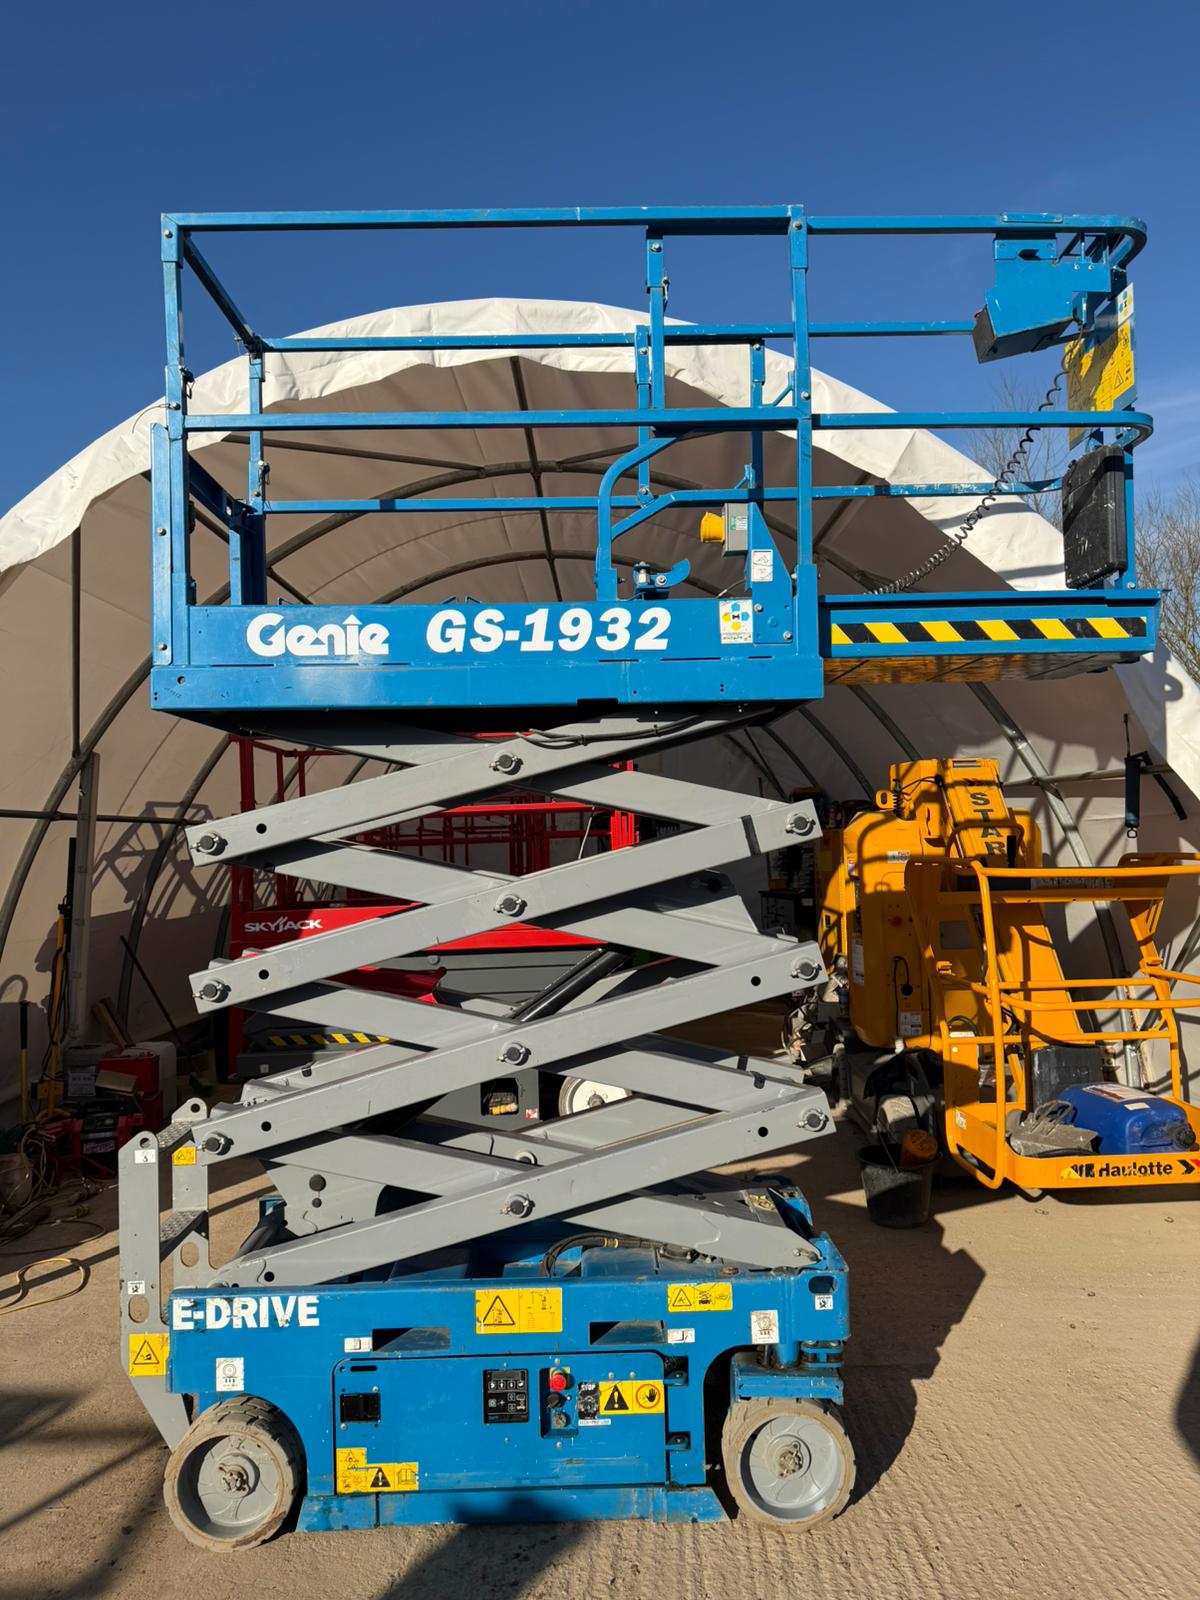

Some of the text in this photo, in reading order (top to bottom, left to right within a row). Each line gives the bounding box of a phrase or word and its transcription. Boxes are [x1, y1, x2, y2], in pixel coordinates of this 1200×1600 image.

[246, 607, 671, 656] Genie GS-1932
[970, 792, 1006, 855] STAR
[244, 916, 323, 933] SKYJACK
[172, 1295, 320, 1331] E-DRIVE
